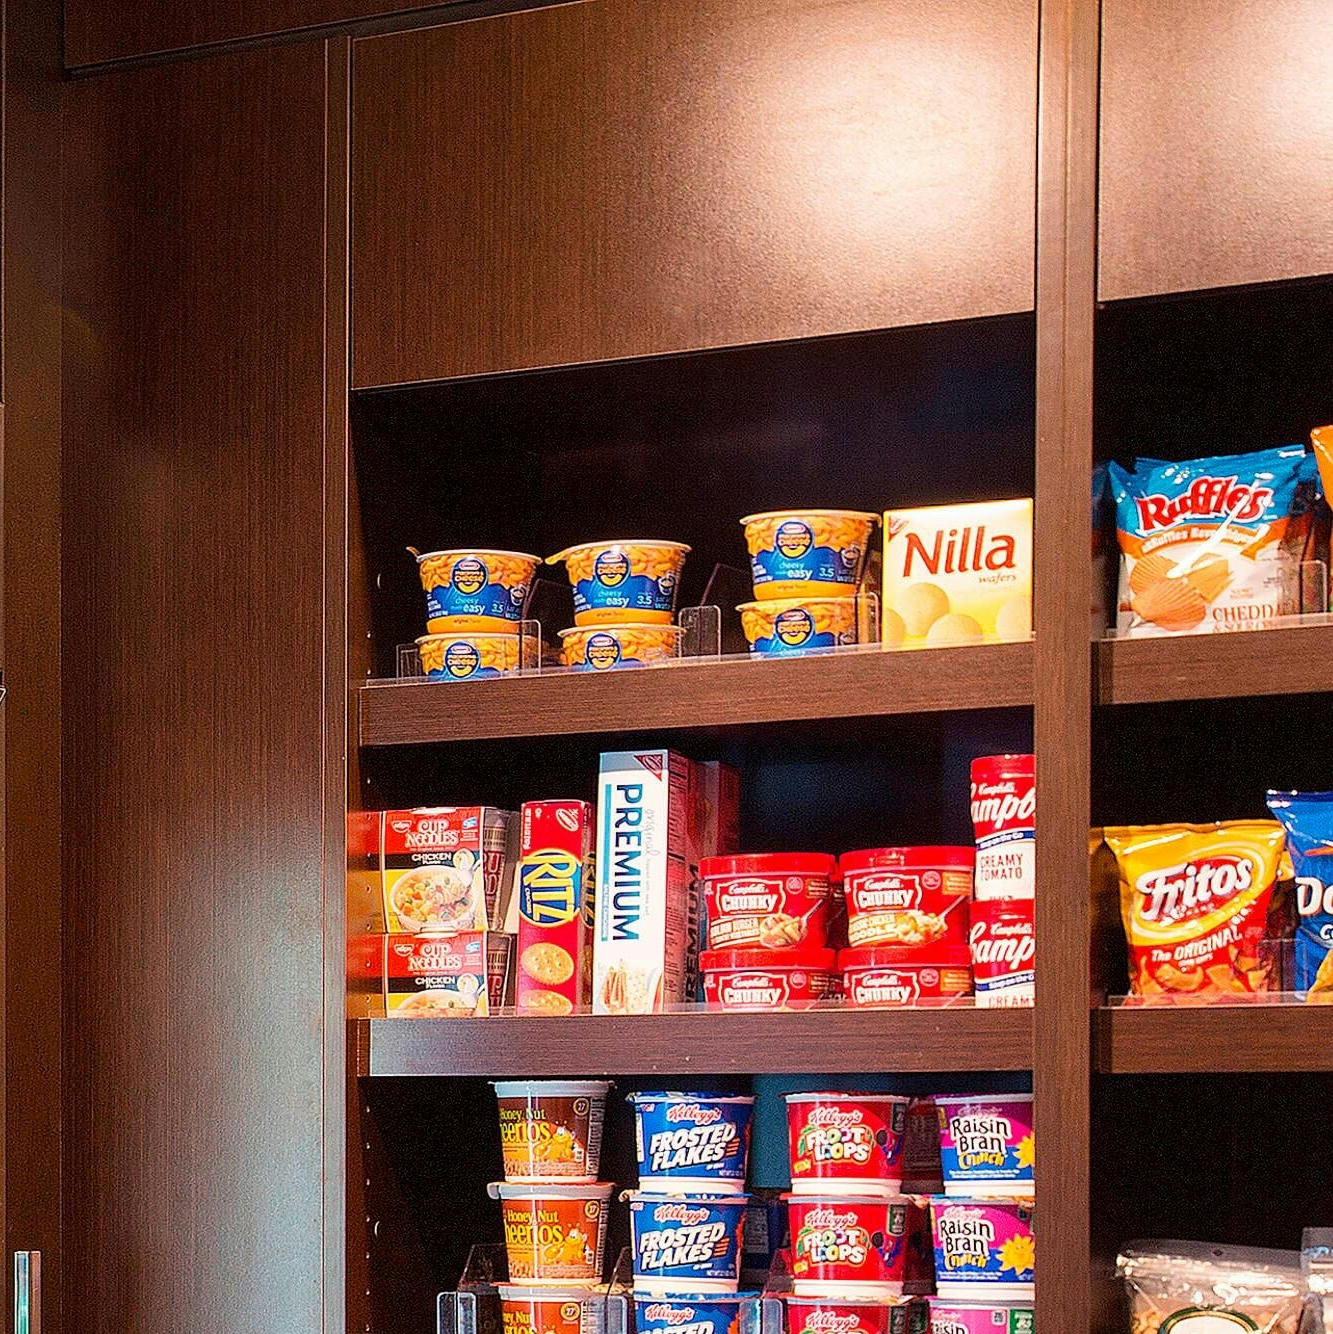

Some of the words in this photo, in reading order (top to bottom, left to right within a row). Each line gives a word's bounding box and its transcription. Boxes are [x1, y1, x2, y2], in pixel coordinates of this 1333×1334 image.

[1135, 475, 1275, 533] Ruffles
[902, 525, 1017, 578] Nilla
[778, 560, 804, 571] cheesy
[787, 568, 813, 580] easy
[819, 567, 835, 578] 3.5
[977, 571, 1018, 585] wafers
[463, 602, 486, 615] easy
[491, 602, 504, 614] 3.5
[605, 595, 630, 608] easy
[636, 595, 653, 605] 3.5
[418, 819, 450, 834] CUP
[405, 831, 460, 849] NOODLES
[411, 852, 453, 862] CHICKEN
[612, 782, 643, 942] PREMIUM
[979, 853, 1024, 869] CREAMY
[979, 867, 1023, 881] TOMATO
[523, 855, 577, 922] RITZ
[1135, 858, 1254, 922] Fritos
[721, 894, 779, 913] CHUNKY
[857, 889, 914, 909] CHUNKY
[420, 942, 452, 957] CUP
[1151, 948, 1172, 962] The
[1174, 925, 1243, 962] ORIGINAL
[408, 955, 463, 972] NOODLES
[414, 976, 456, 986] CHICKEN
[723, 987, 783, 1005] CHUNKY
[855, 985, 912, 1004] CHUNKY
[526, 1107, 546, 1120] Nut
[666, 1103, 722, 1123] Kellogg's
[808, 1107, 863, 1125] Kellogg's
[805, 1126, 866, 1145] FROOT
[951, 1117, 1008, 1137] Raisin
[650, 1123, 737, 1155] FROSTED
[958, 1135, 1003, 1153] Bran
[651, 1142, 725, 1172] FLAKES
[814, 1141, 871, 1163] LOOPS
[958, 1151, 1006, 1169] Crunch
[507, 1209, 533, 1226] Honey
[536, 1209, 559, 1223] Nut
[654, 1204, 709, 1224] Kellogg's
[804, 1208, 858, 1227] Kellogg's
[639, 1221, 725, 1254] FROSTED
[802, 1228, 861, 1247] FROOT
[939, 1219, 991, 1238] Raisin
[810, 1244, 866, 1264] LOOPS
[945, 1236, 985, 1254] Bran
[641, 1242, 714, 1271] FLAKES
[944, 1252, 987, 1270] Crunch
[518, 1310, 534, 1324] Nut
[644, 1304, 695, 1324] Kellogg's
[805, 1310, 859, 1329] Kellogg's
